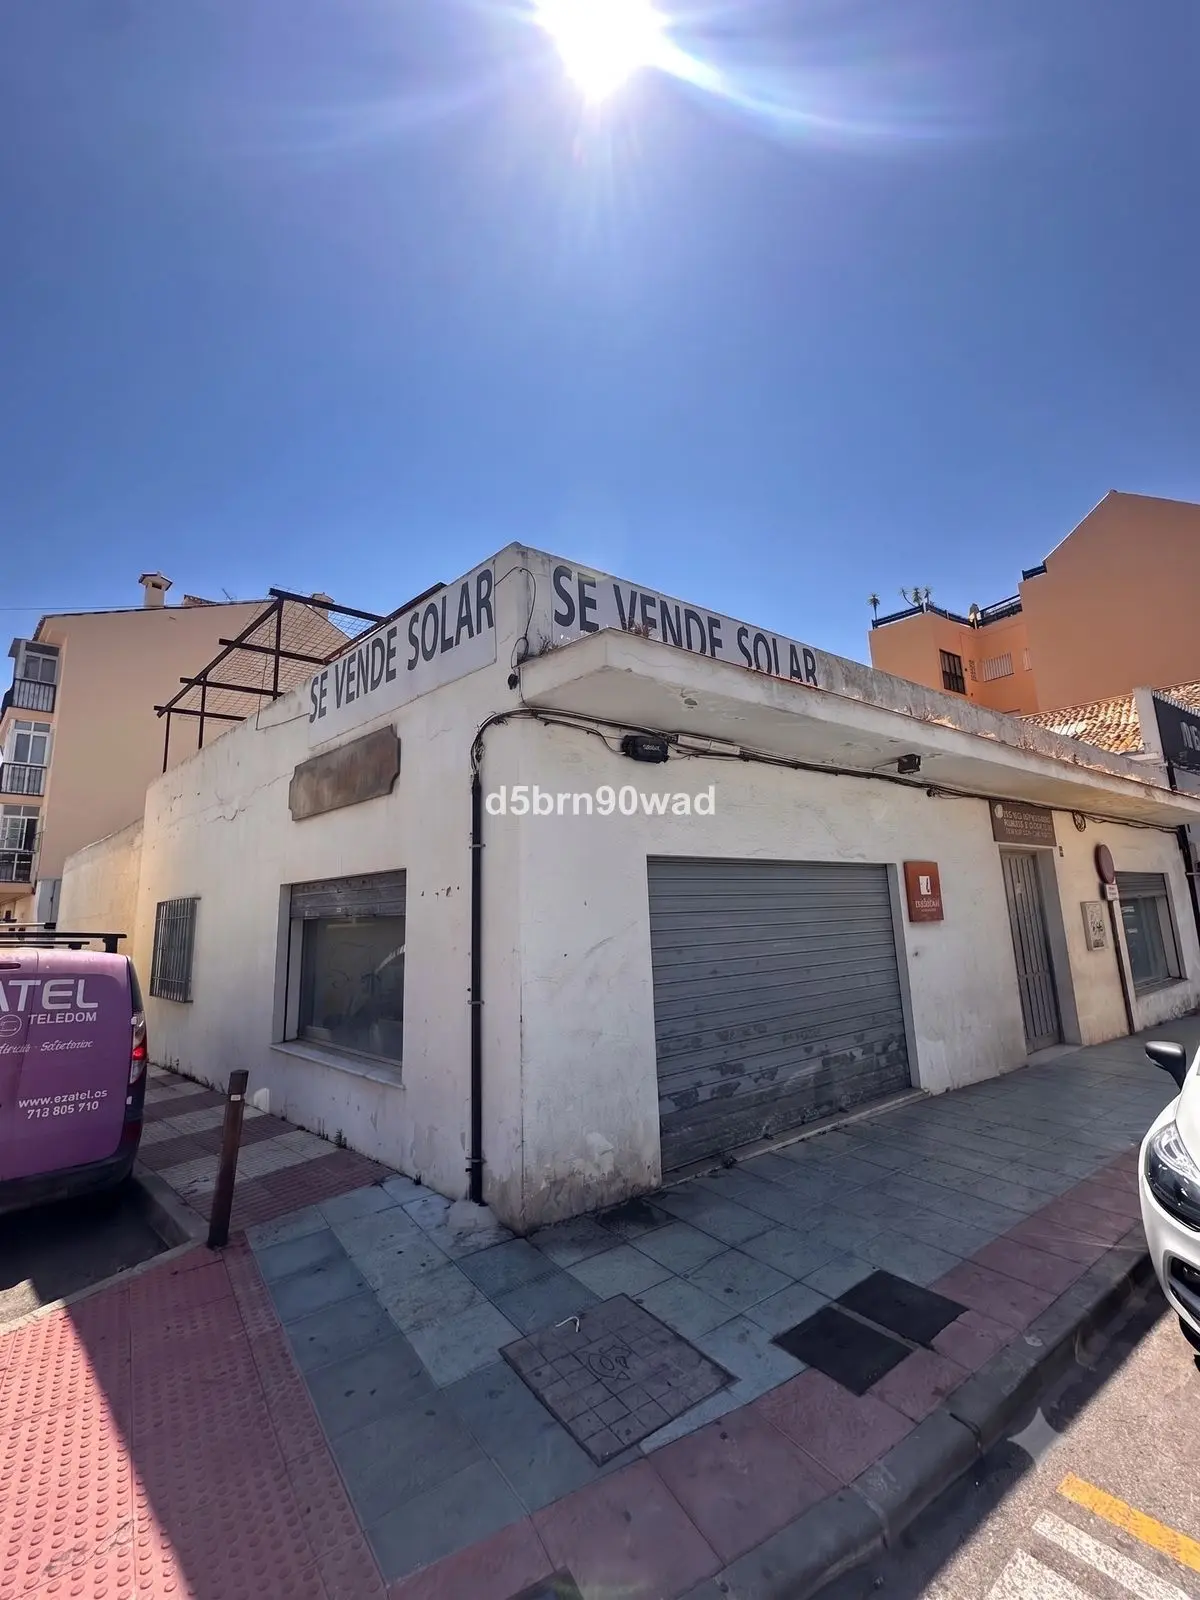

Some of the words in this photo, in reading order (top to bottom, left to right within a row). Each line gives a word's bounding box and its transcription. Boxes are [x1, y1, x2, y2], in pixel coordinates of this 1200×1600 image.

[553, 565, 599, 633] SE
[613, 583, 723, 658] VENDE
[309, 670, 328, 723] SE
[335, 626, 397, 709] VENDE
[407, 568, 494, 671] SOLAR
[28, 1012, 97, 1025] TELEDOM
[52, 1104, 75, 1116] 805
[78, 1100, 99, 1113] 710
